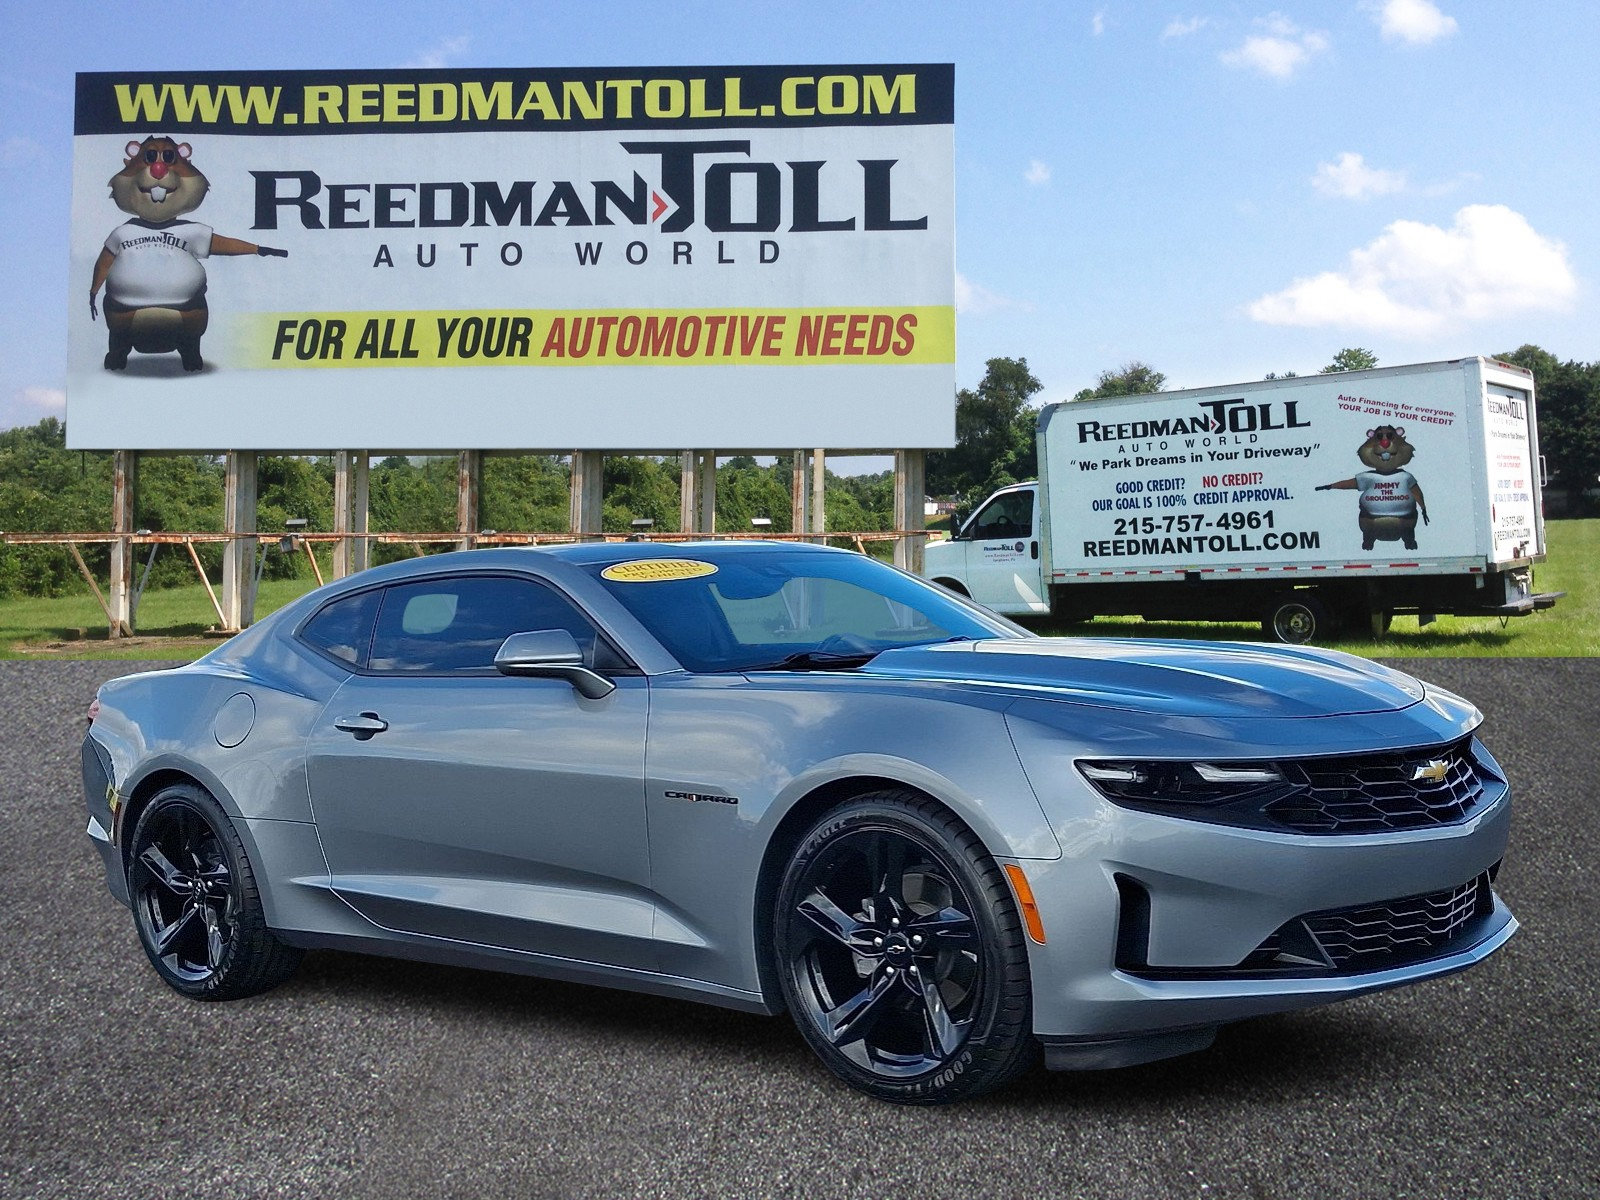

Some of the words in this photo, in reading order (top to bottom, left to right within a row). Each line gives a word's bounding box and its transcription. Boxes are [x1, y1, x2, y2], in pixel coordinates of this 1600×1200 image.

[114, 73, 917, 125] WWW.REEDMANTOLL.COM
[373, 241, 523, 268] AUTO
[575, 240, 780, 266] WORLD
[272, 319, 347, 361] FOR
[354, 318, 420, 360] ALL
[436, 317, 534, 358] YOUR
[541, 315, 786, 358] AUTOMOTIVE
[795, 313, 918, 357] NEEDS
[1338, 394, 1357, 403] Auto
[1359, 397, 1399, 410] Financing
[1401, 403, 1413, 411] for
[1415, 406, 1457, 417] everyone.
[1338, 403, 1361, 412] YOUR
[1363, 406, 1381, 415] JOB
[1383, 409, 1392, 417] IS
[1394, 411, 1418, 421] YOUR
[1420, 415, 1454, 426] CREDIT
[1118, 441, 1169, 454] AUTO
[1185, 433, 1258, 449] WORLD
[1102, 457, 1131, 470] Park
[1136, 454, 1187, 467] Dreams
[1190, 452, 1203, 463] in
[1207, 450, 1239, 461] Your
[1116, 481, 1143, 494] GOOD
[1147, 477, 1186, 492] CREDIT?
[1203, 475, 1219, 488] NO
[1222, 472, 1263, 487] CREDIT?
[1092, 499, 1113, 512] OUR
[1115, 497, 1141, 510] GOAL
[1143, 496, 1153, 508] IS
[1156, 493, 1187, 507] 100%
[1193, 491, 1229, 505] CREDIT
[1231, 487, 1294, 503] APPROVAL.
[1114, 510, 1274, 535] 215-757-4961
[1083, 531, 1321, 557] REEDMANTOLL.COM
[611, 562, 701, 574] CERTIFIED
